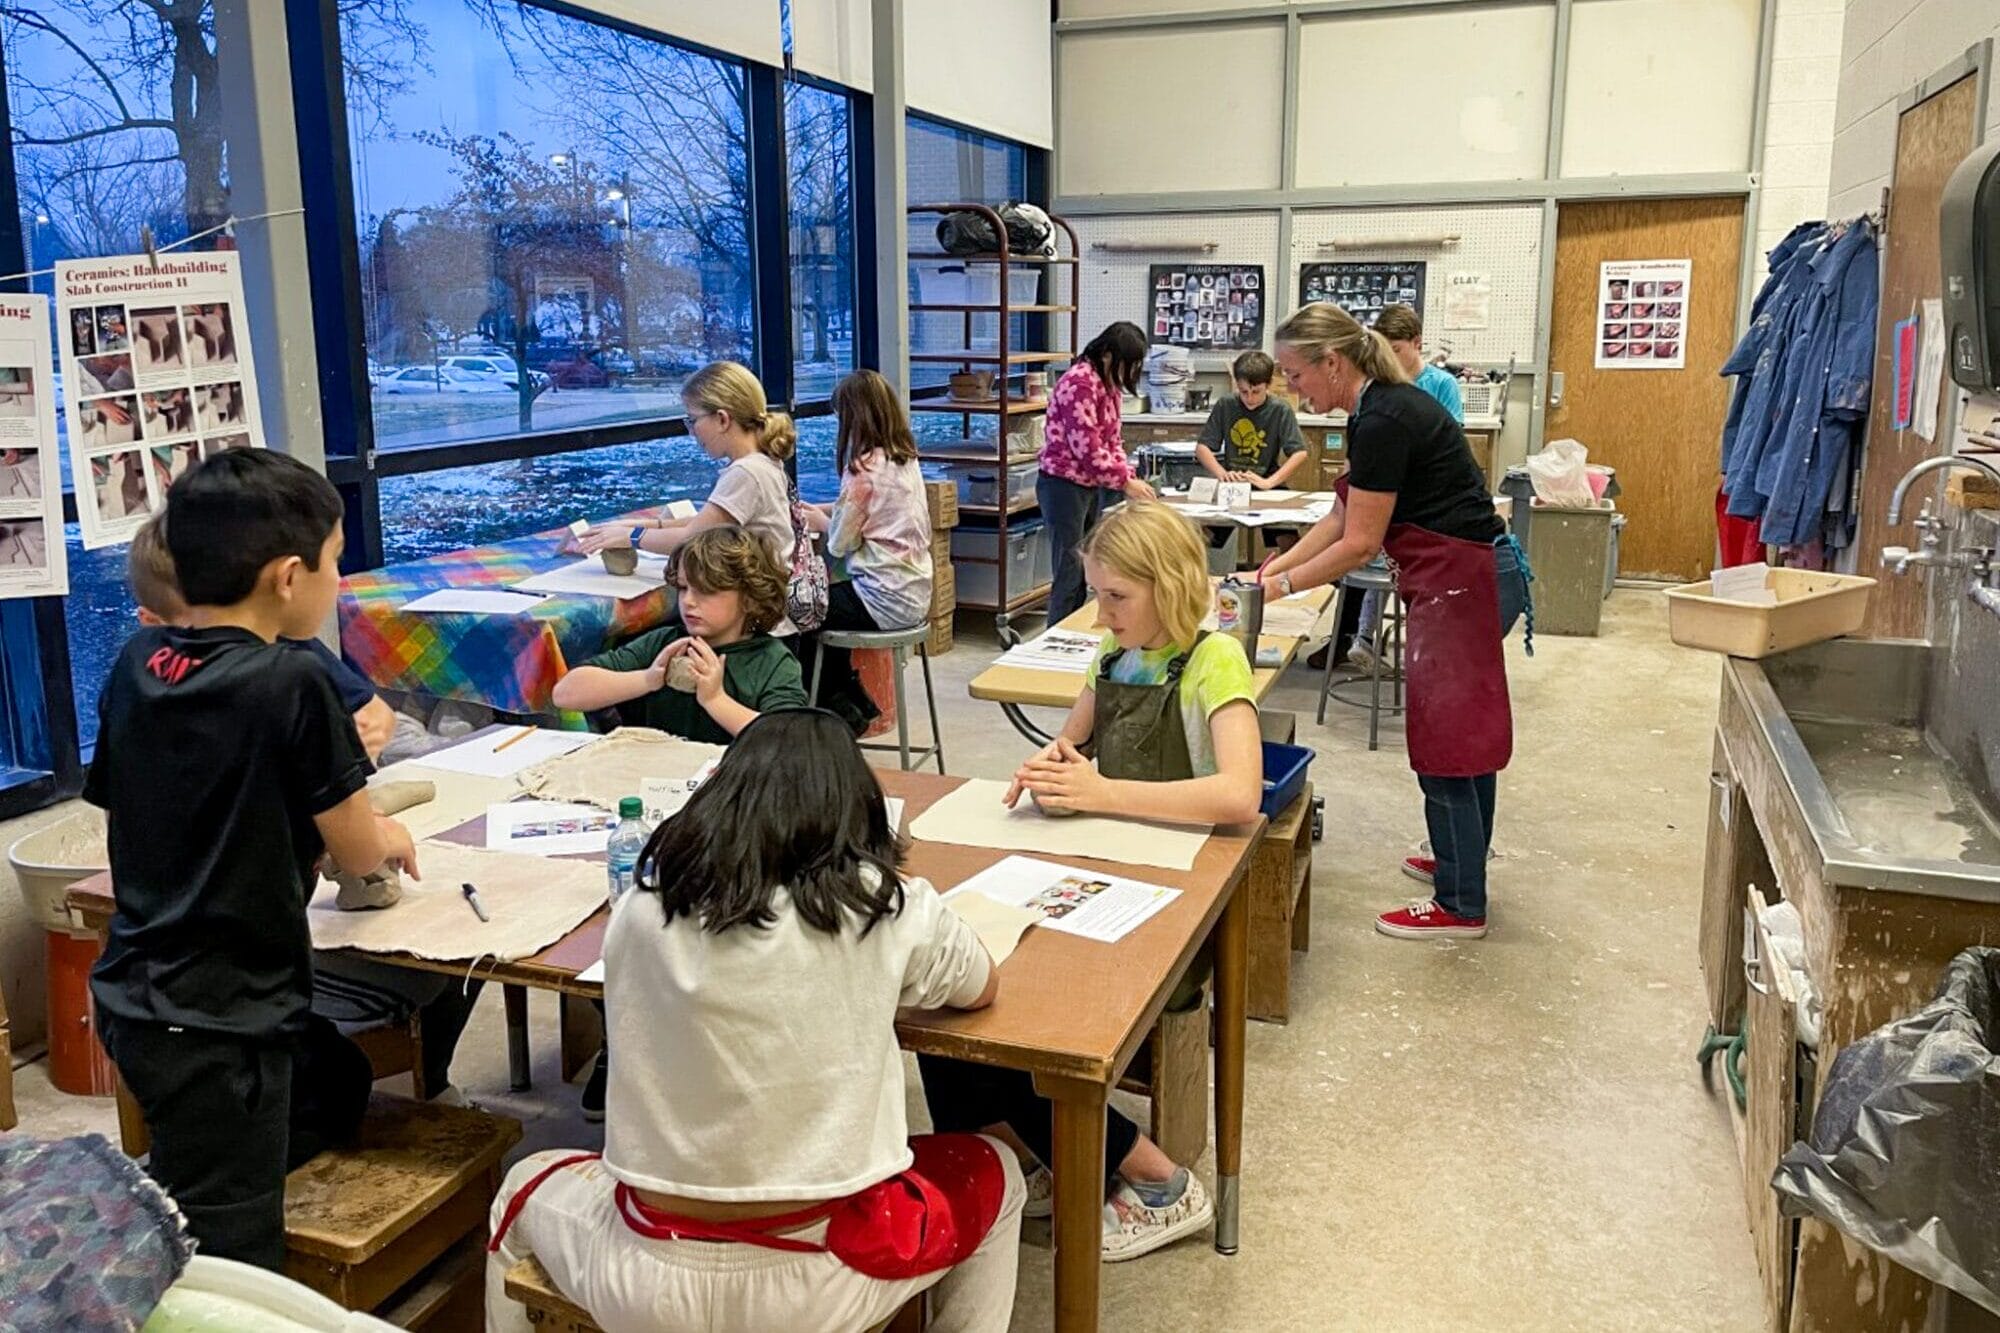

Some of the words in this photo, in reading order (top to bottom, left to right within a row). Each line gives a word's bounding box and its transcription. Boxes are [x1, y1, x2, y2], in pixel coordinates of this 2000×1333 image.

[65, 265, 130, 282] Ceramics:
[134, 261, 228, 276] Handbuilding
[1453, 276, 1481, 285] CLAY
[65, 283, 92, 297] Slab
[95, 278, 173, 293] Construction
[176, 276, 188, 288] II
